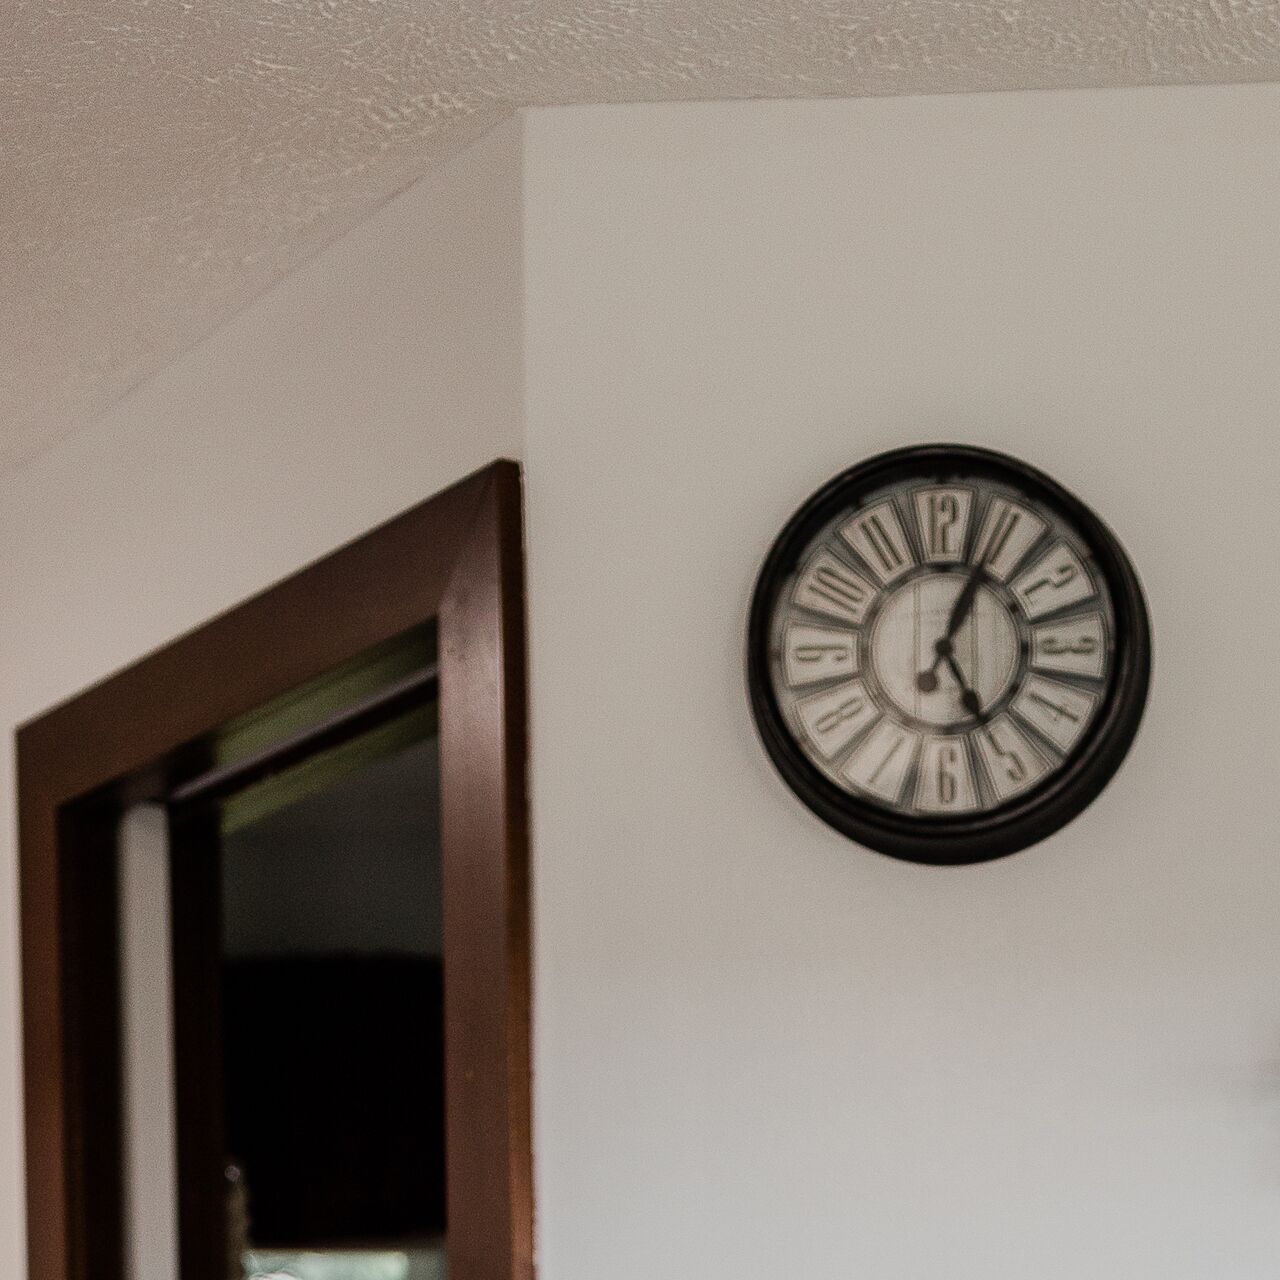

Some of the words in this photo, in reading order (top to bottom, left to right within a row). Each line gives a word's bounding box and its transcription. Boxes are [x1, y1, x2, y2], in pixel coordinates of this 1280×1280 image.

[859, 514, 904, 572] 11
[927, 494, 960, 554] 12
[808, 565, 866, 614] 10
[1023, 564, 1078, 608] 2
[793, 643, 849, 663] 9
[1038, 633, 1098, 656] 3
[814, 698, 866, 735] 8
[937, 747, 957, 805] 6
[985, 727, 1028, 783] 5
